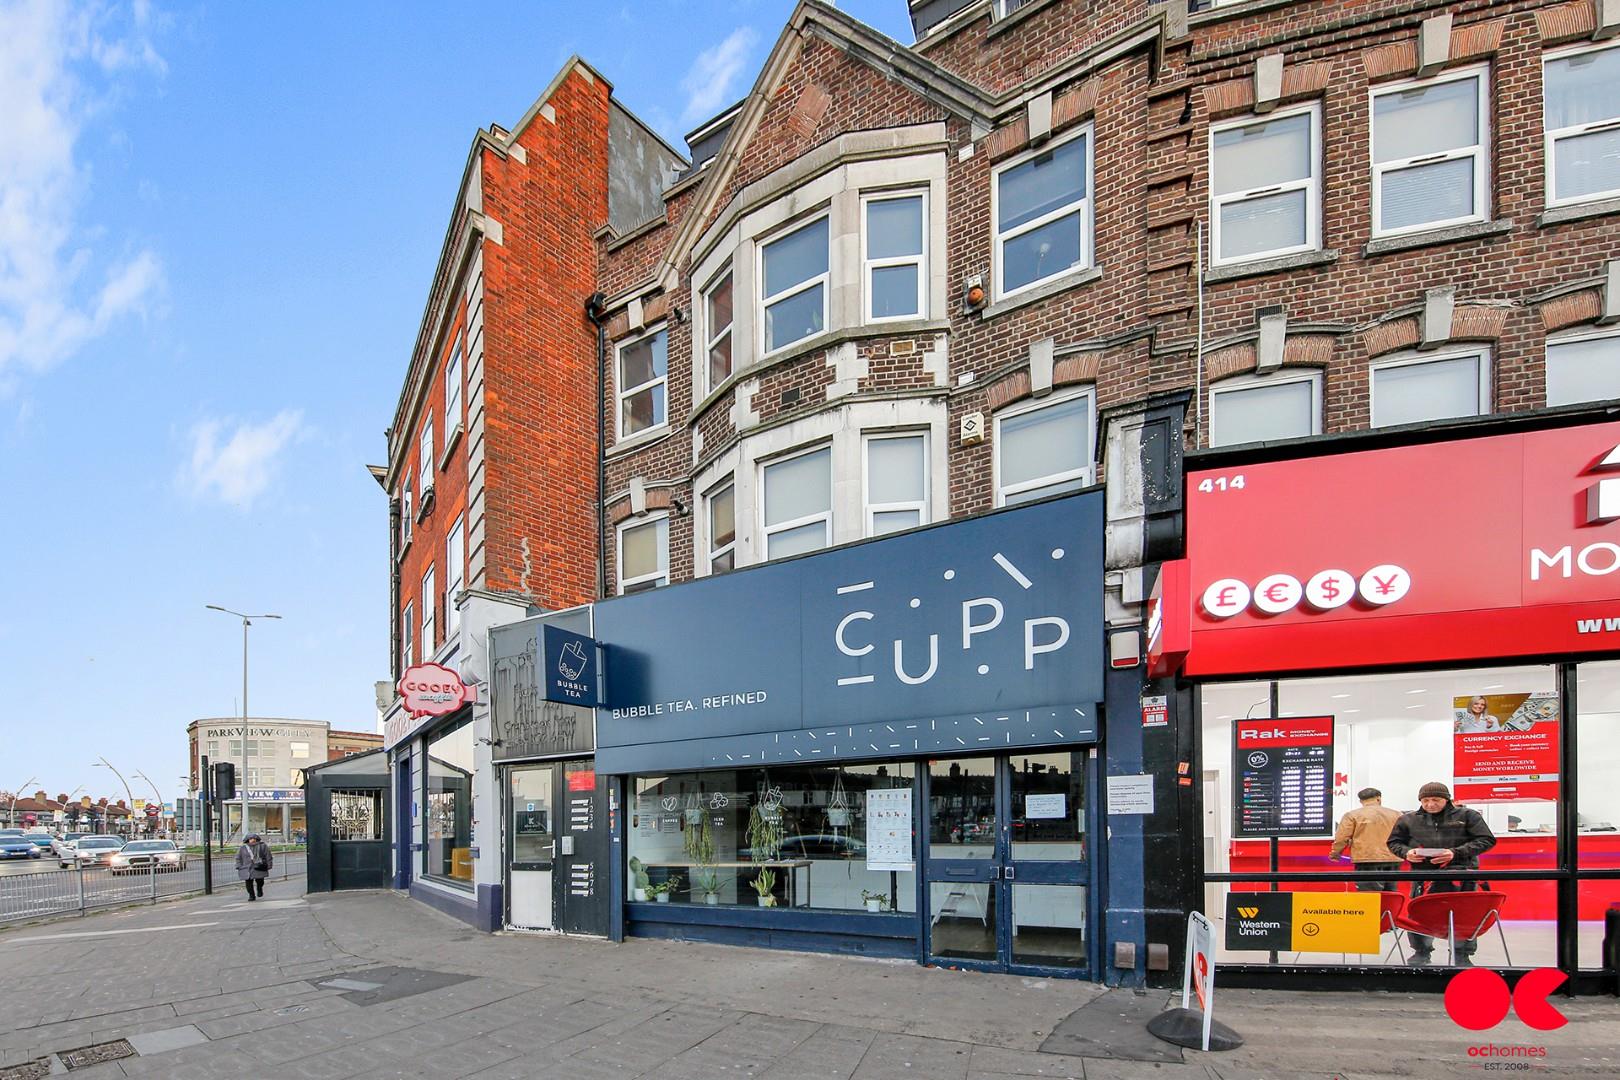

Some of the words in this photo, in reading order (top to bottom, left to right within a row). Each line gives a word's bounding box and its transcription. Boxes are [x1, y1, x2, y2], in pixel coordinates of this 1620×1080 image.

[1198, 474, 1246, 492] 414
[406, 682, 459, 694] GOOEY
[558, 680, 588, 692] BUBBLE
[612, 704, 663, 720] BUBBLE
[668, 700, 698, 712] TEA.
[703, 691, 767, 708] REFINED
[1240, 728, 1287, 740] Rak
[1250, 754, 1265, 763] 0%
[1240, 920, 1280, 929] Western
